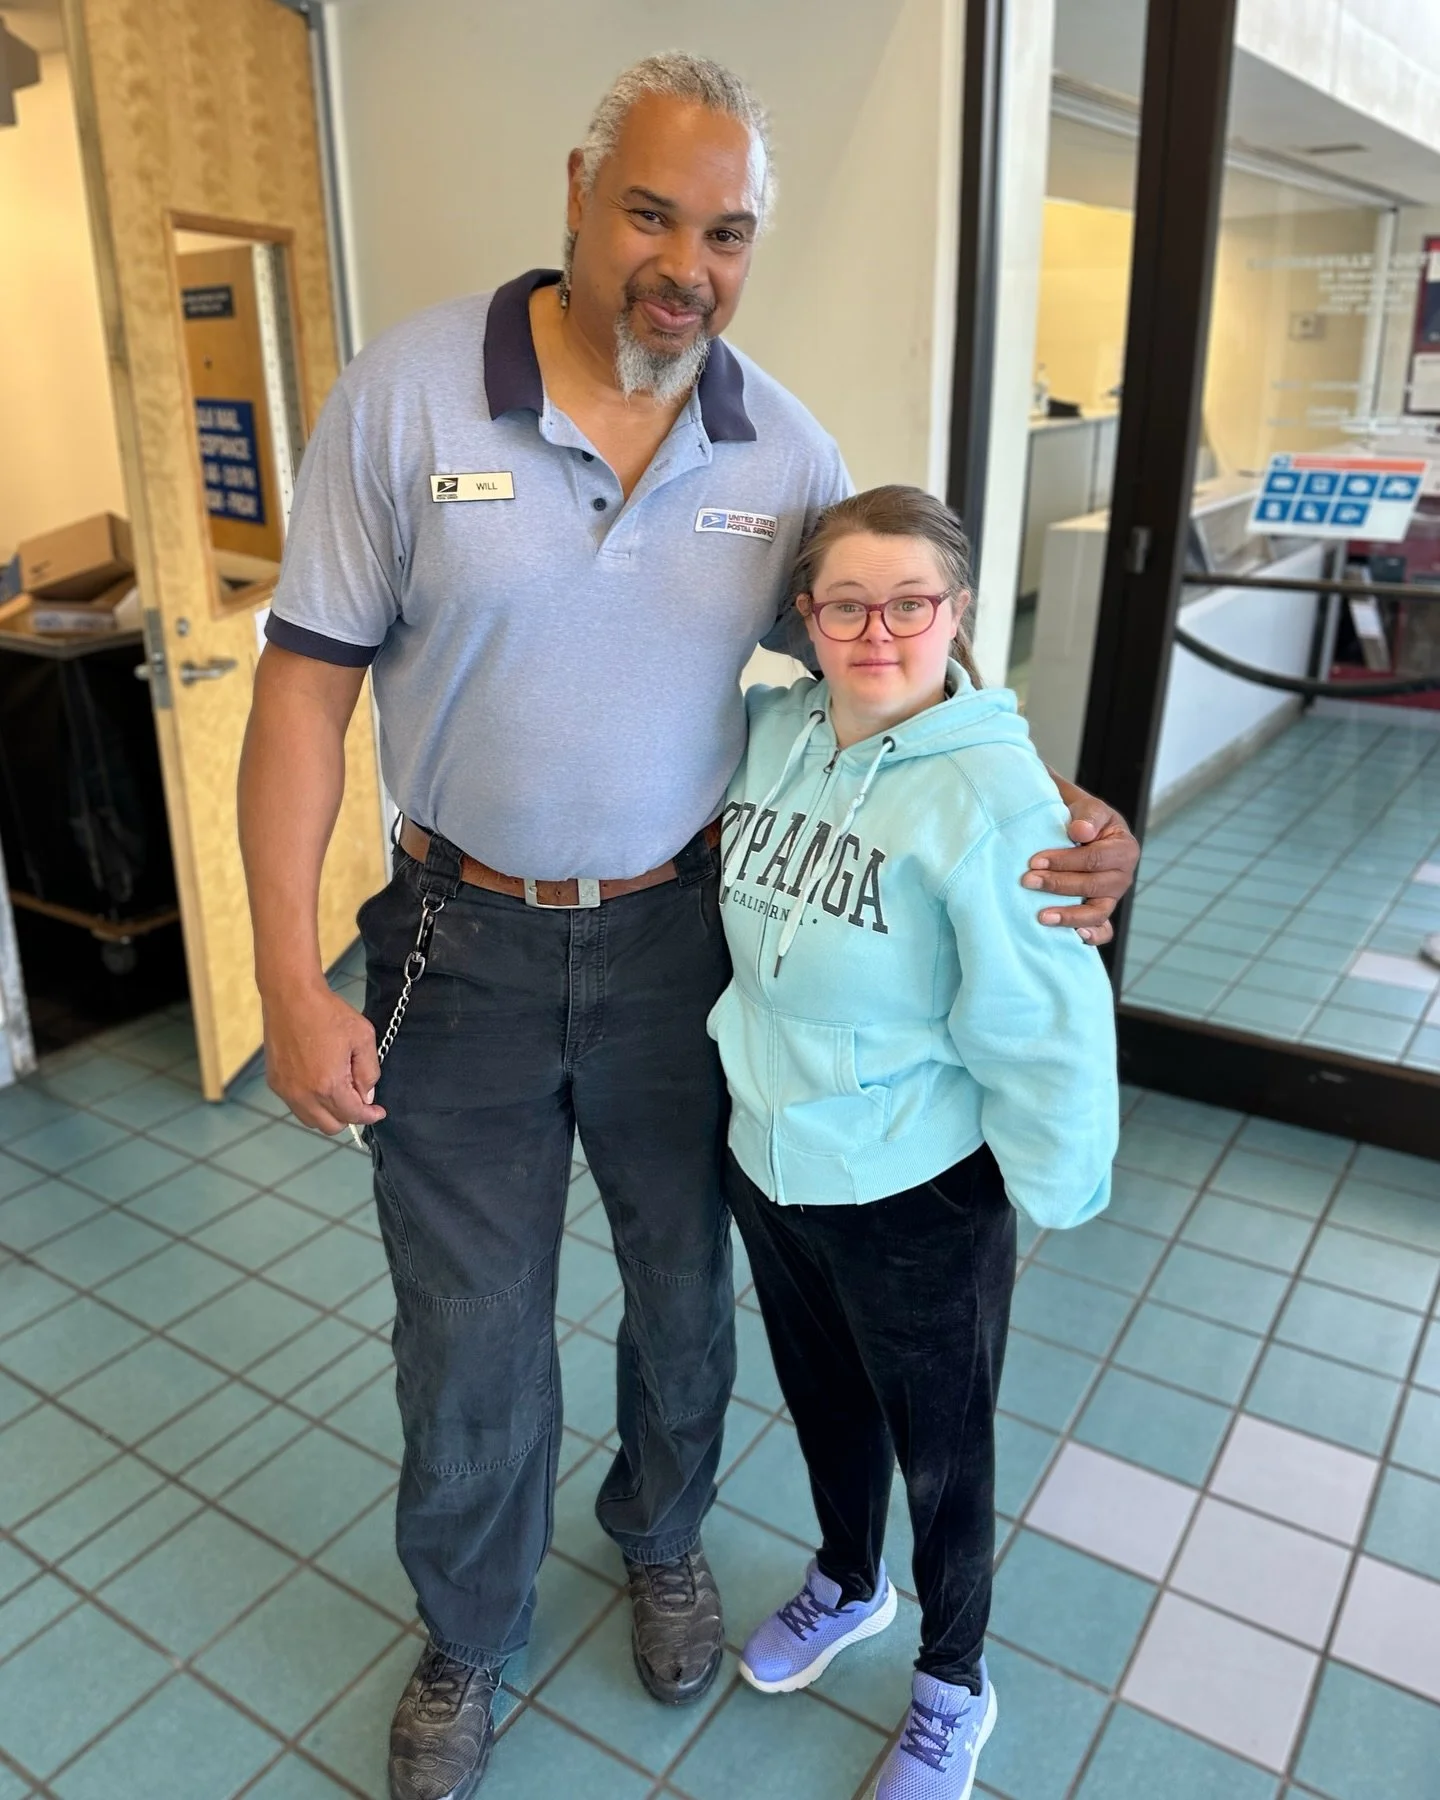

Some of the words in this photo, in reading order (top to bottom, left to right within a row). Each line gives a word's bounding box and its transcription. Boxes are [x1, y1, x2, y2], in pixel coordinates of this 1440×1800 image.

[476, 482, 498, 491] WILL
[728, 514, 753, 523] UNITED
[755, 517, 776, 528] STATES
[727, 523, 752, 533] POSTAL
[752, 526, 775, 538] SERVICE
